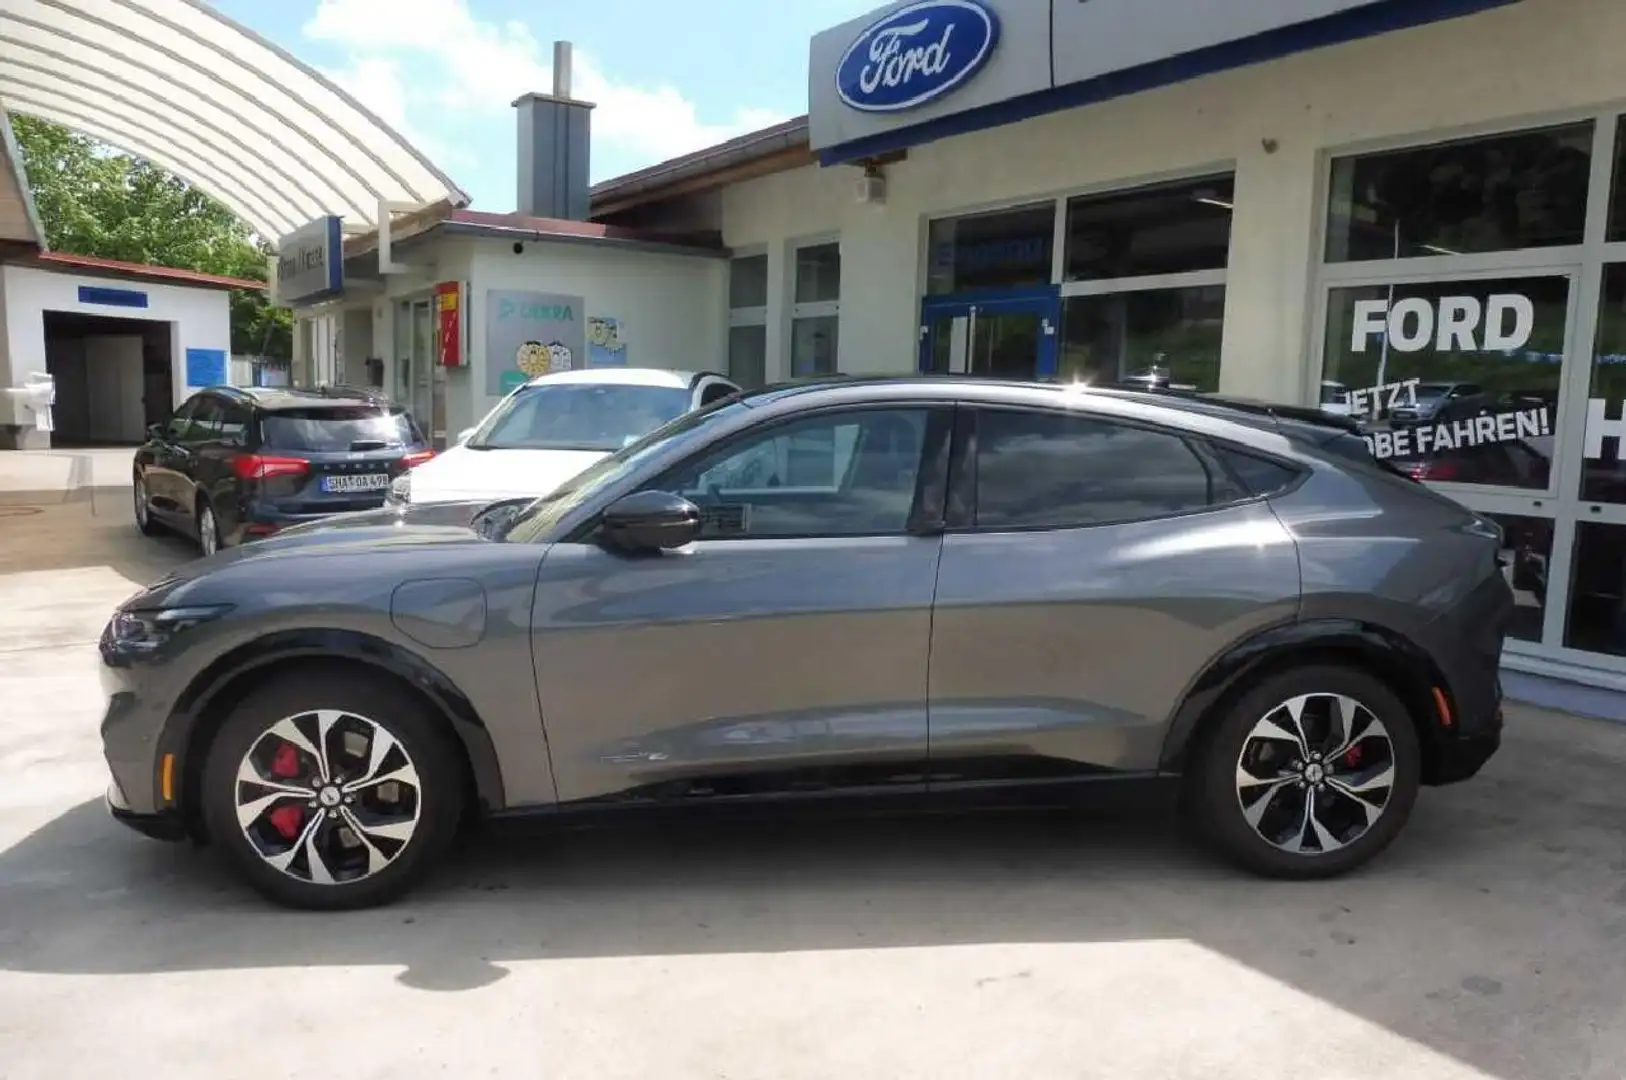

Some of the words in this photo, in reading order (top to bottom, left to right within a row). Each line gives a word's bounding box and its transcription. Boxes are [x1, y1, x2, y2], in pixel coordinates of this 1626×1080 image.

[859, 18, 955, 94] Ford
[1351, 293, 1534, 352] FORD
[1416, 407, 1550, 454] FAHREN!
